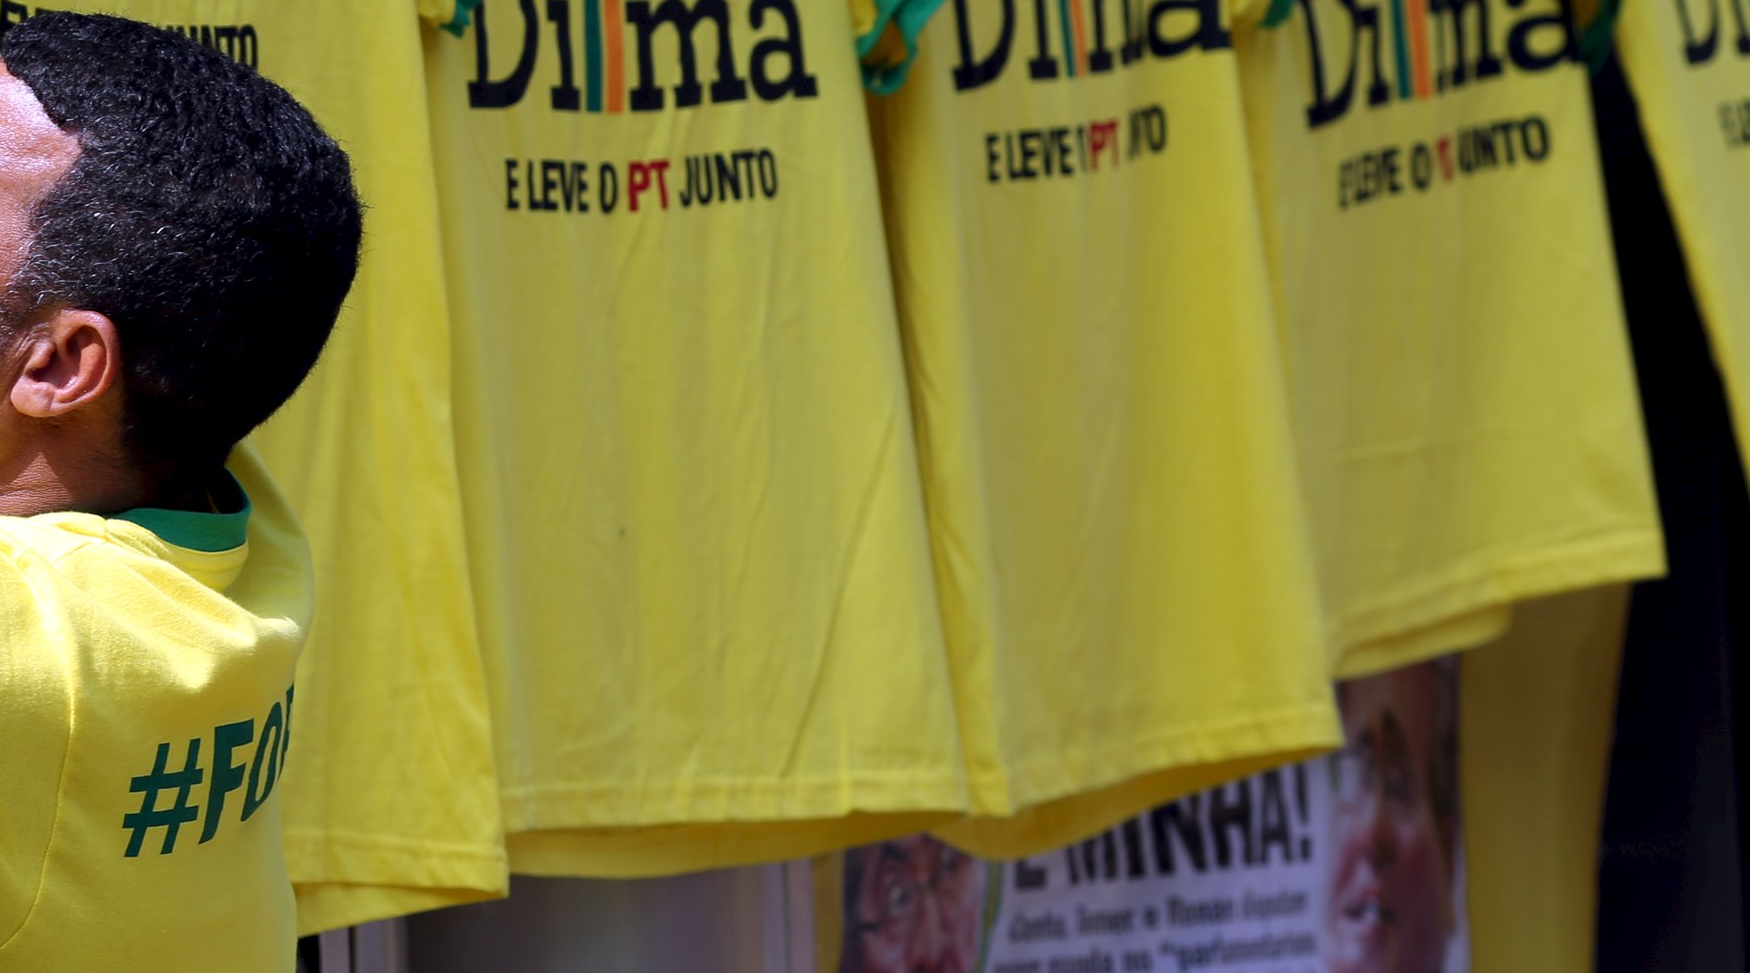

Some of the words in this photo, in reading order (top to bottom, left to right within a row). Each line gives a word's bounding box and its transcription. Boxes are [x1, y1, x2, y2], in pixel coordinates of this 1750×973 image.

[505, 159, 520, 210] E
[527, 160, 589, 213] LEVE
[599, 161, 618, 214] O
[628, 160, 670, 212] PT
[680, 148, 778, 207] JUNTO
[985, 132, 1001, 184] E
[1006, 127, 1074, 182] LEVE
[1090, 118, 1119, 173] PT
[1411, 141, 1432, 191] O
[1457, 114, 1551, 175] UNTO
